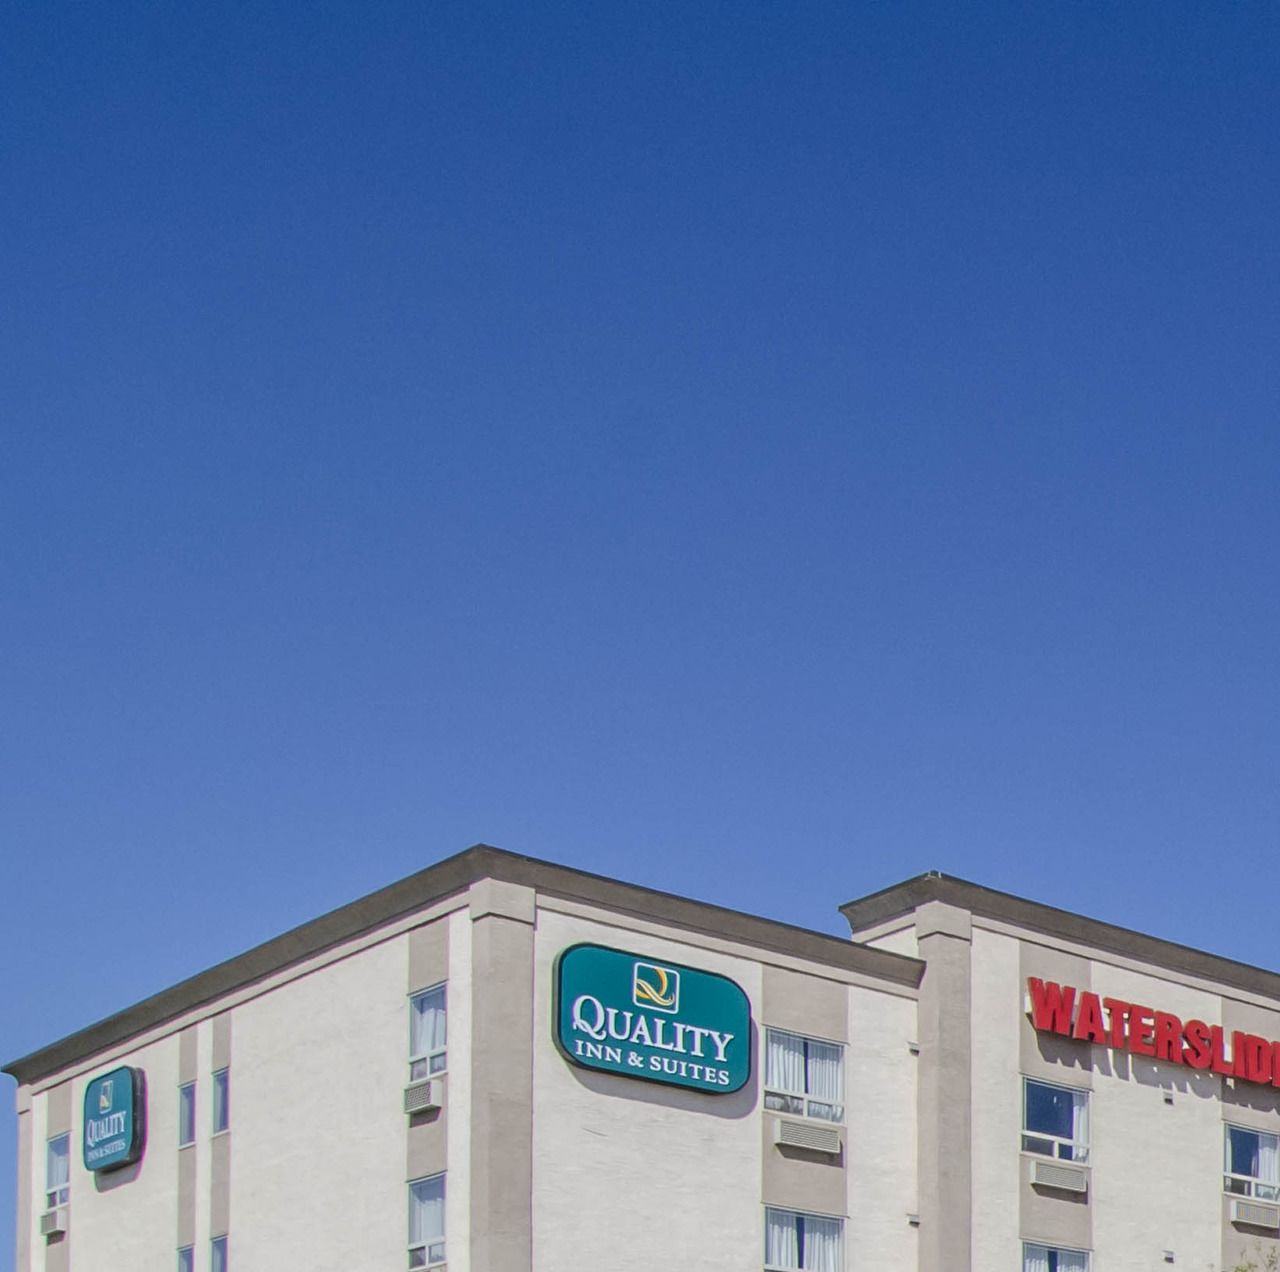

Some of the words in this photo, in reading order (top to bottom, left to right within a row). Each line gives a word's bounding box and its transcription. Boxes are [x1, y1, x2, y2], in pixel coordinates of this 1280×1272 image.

[572, 995, 734, 1062] QUALITY
[575, 1039, 622, 1064] INN
[628, 1051, 644, 1068] &
[649, 1055, 730, 1085] SUITES
[87, 1110, 127, 1148] QUALITY
